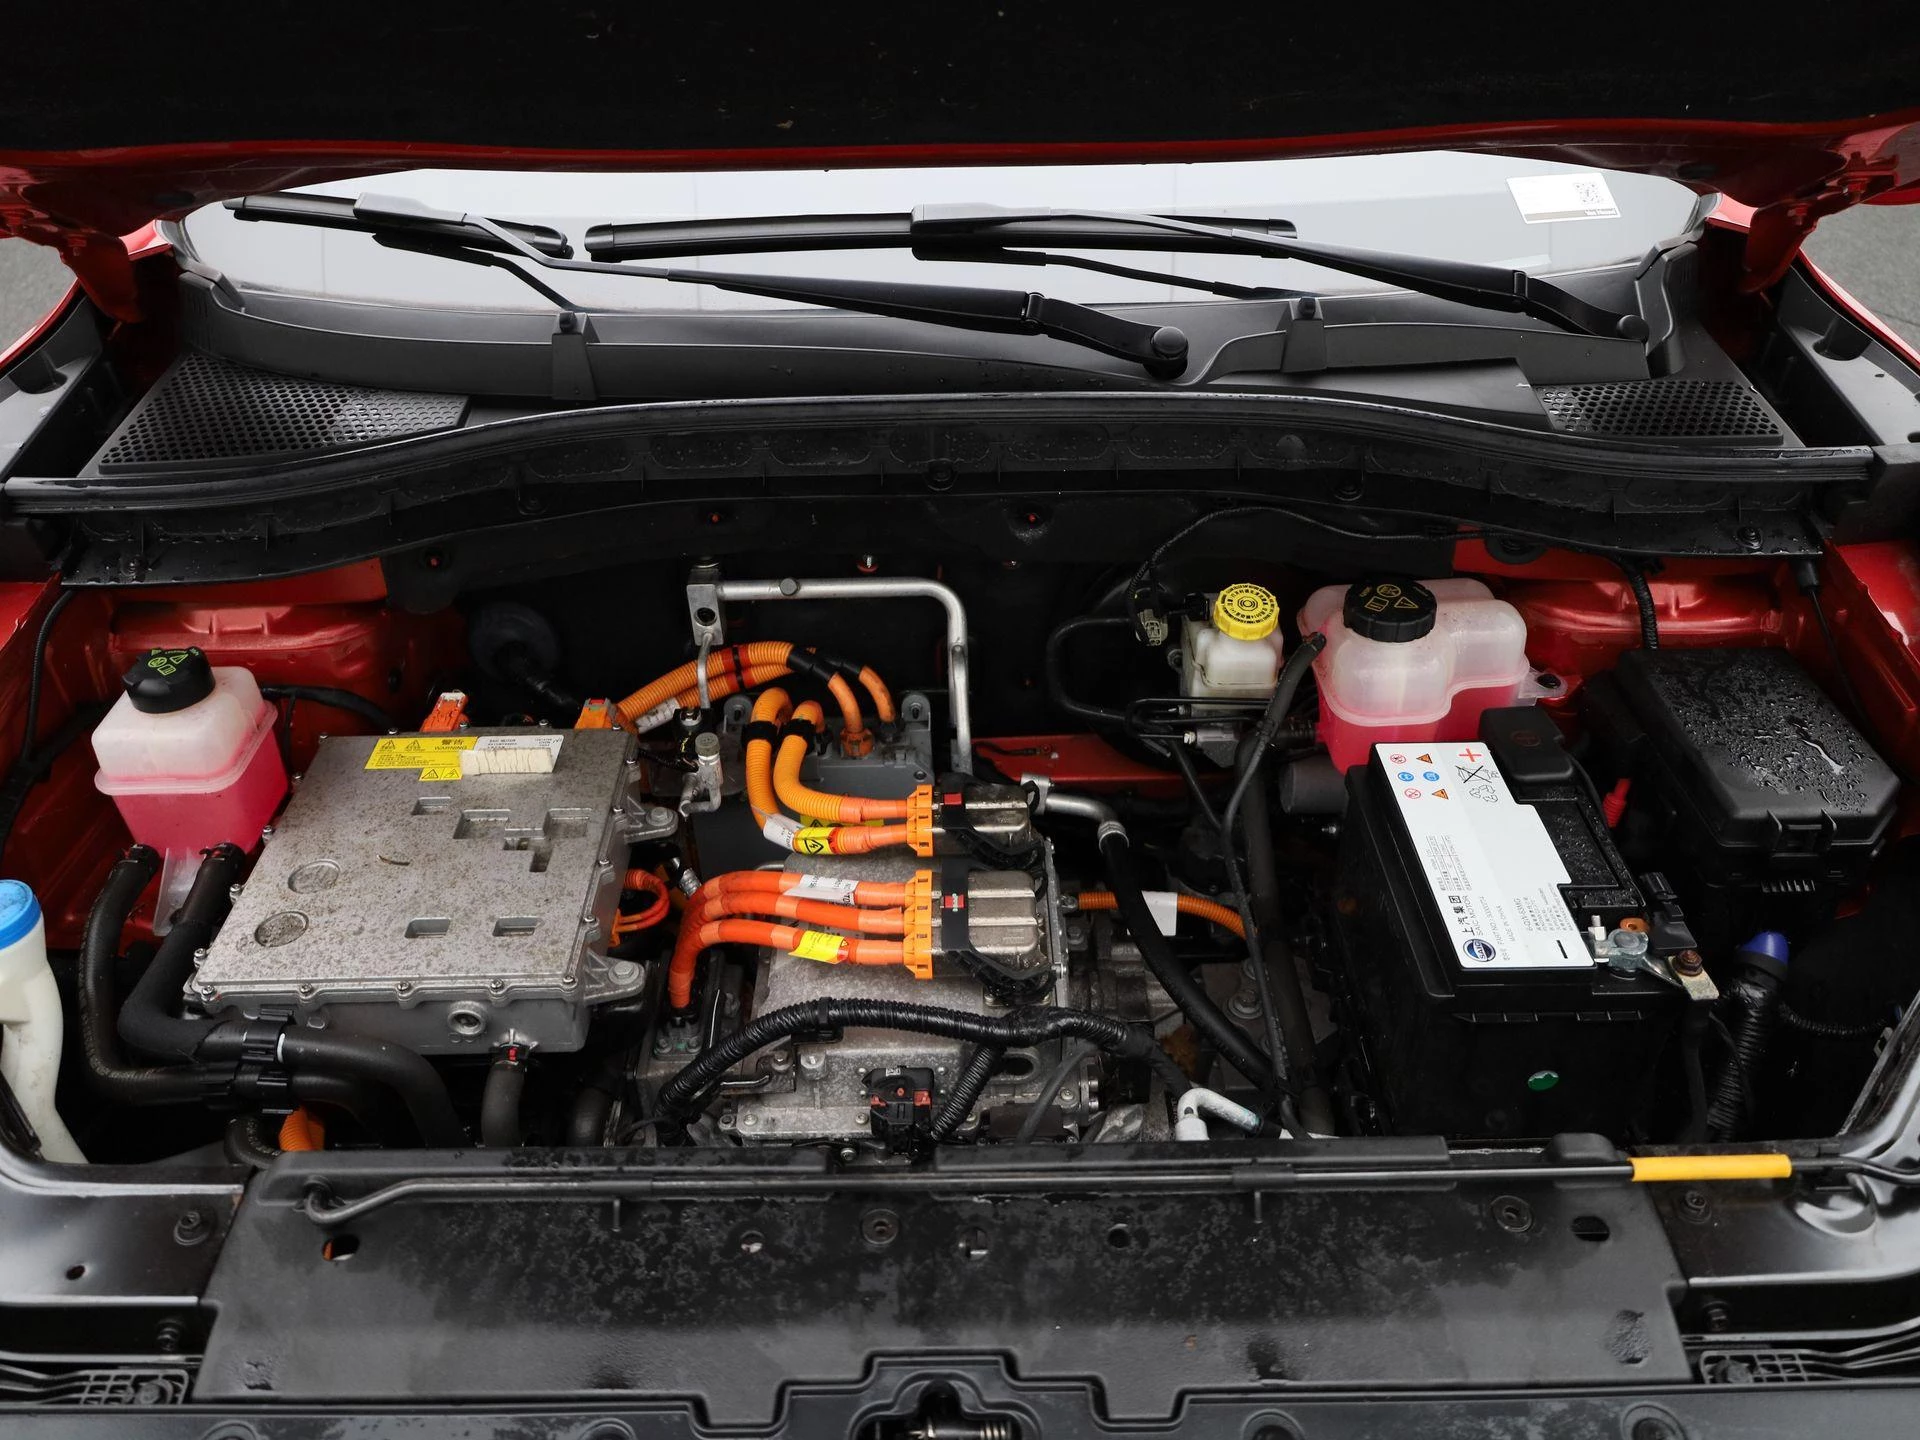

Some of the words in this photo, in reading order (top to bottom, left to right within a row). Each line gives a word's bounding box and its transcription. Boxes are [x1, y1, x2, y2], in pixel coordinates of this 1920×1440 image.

[1447, 895, 1475, 935] 上汽集团
[1460, 894, 1477, 918] MOTOR
[1470, 919, 1484, 936] SAIC
[1473, 941, 1486, 959] SAIC
